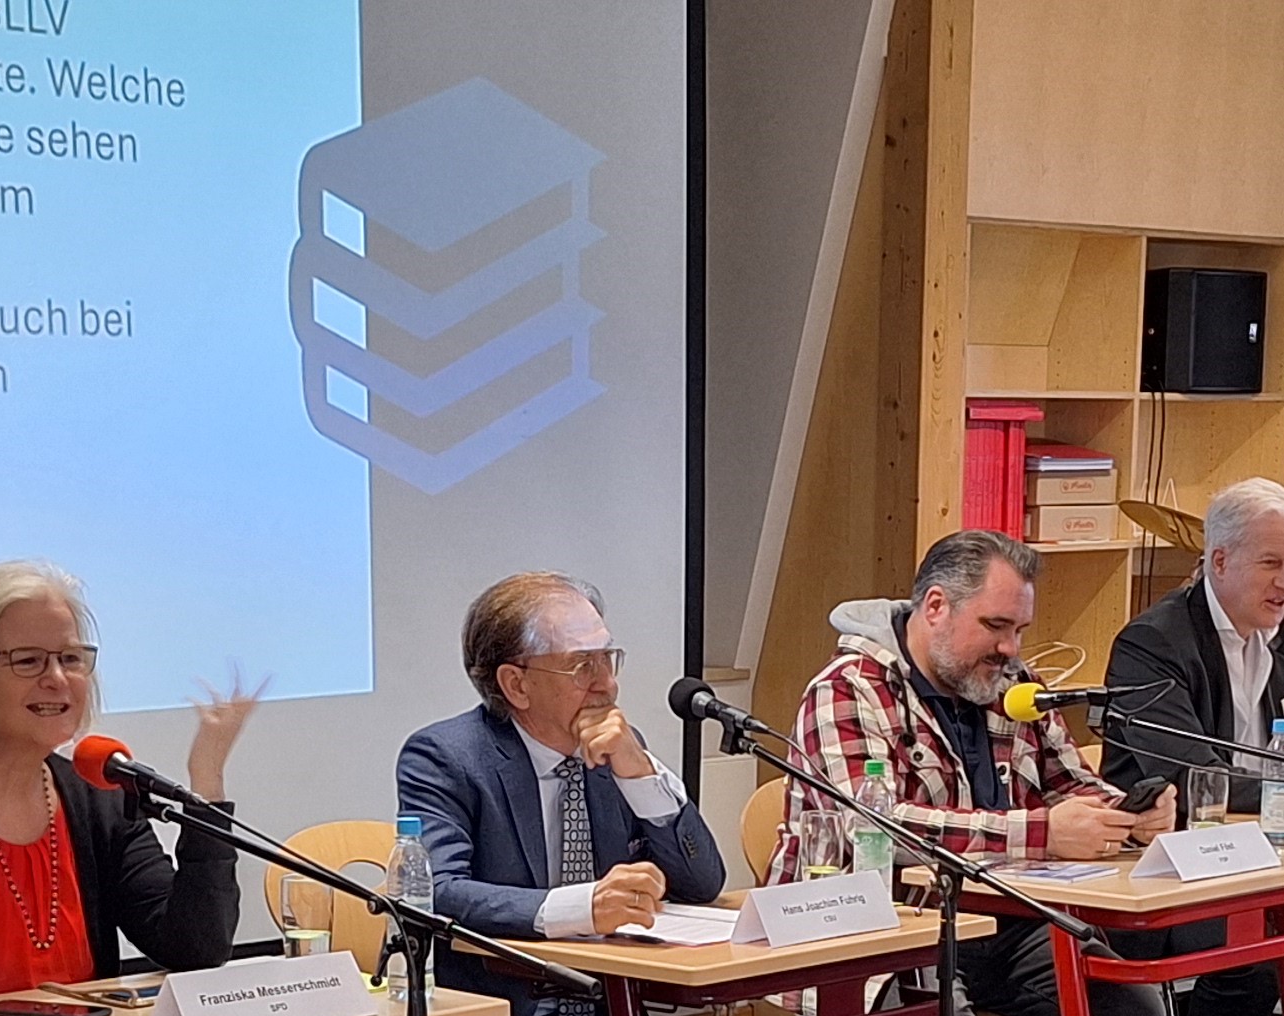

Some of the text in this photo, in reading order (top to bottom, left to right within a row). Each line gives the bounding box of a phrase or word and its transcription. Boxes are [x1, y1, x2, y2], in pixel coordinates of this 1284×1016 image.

[45, 56, 187, 109] Welche
[26, 119, 139, 165] sehen
[79, 298, 134, 339] bei
[782, 903, 804, 915] Hans
[805, 898, 839, 912] Joachim
[199, 976, 342, 1007] Franziska Messerschmidt
